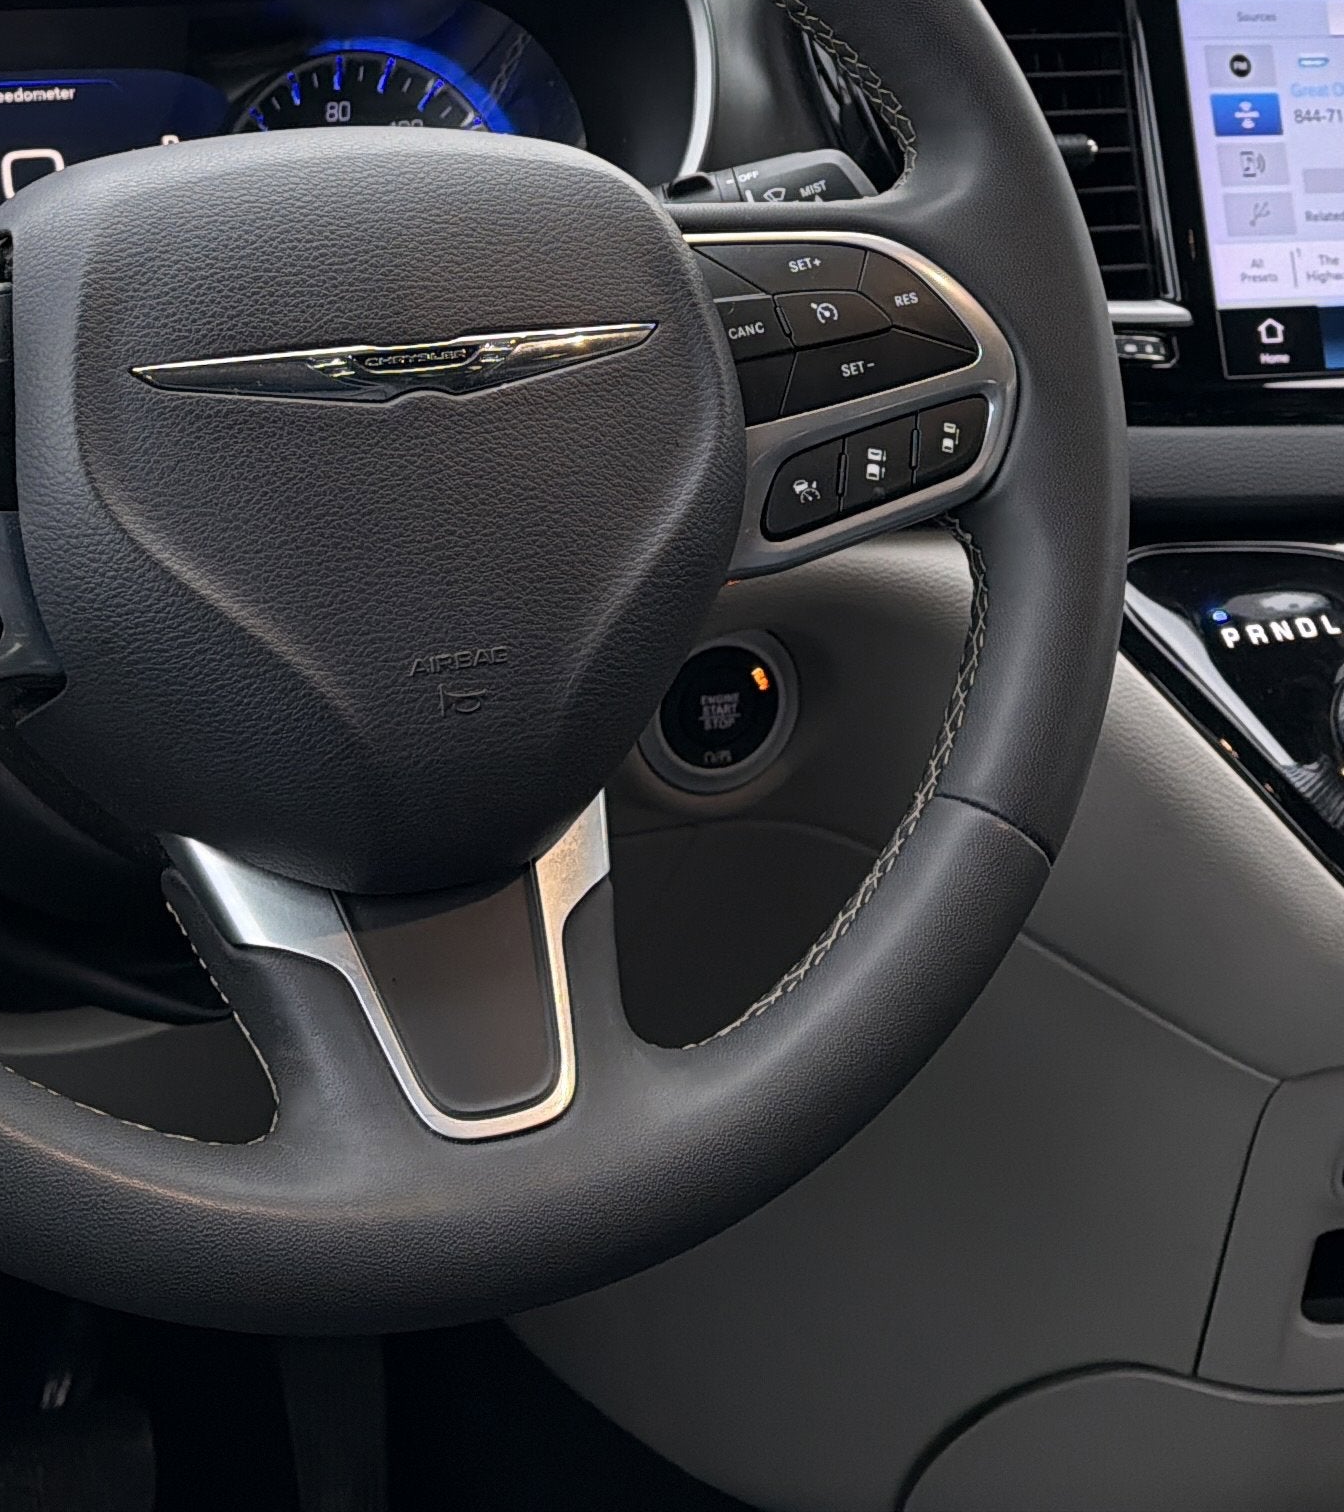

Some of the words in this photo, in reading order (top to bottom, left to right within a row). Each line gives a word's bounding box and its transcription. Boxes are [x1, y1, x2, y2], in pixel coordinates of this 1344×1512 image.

[1236, 9, 1278, 23] Sources
[1290, 83, 1329, 99] Great
[325, 100, 352, 123] 80
[739, 170, 760, 184] OFF
[799, 179, 828, 199] MIST
[788, 257, 822, 273] SET+
[1250, 257, 1265, 270] All
[1318, 253, 1340, 266] The
[1241, 270, 1279, 284] Presets
[893, 291, 919, 308] RES
[727, 320, 766, 340] CANC
[363, 348, 468, 369] CHRYSLER
[1259, 352, 1291, 365] Home
[409, 645, 509, 677] AIRBAG
[702, 702, 738, 718] START
